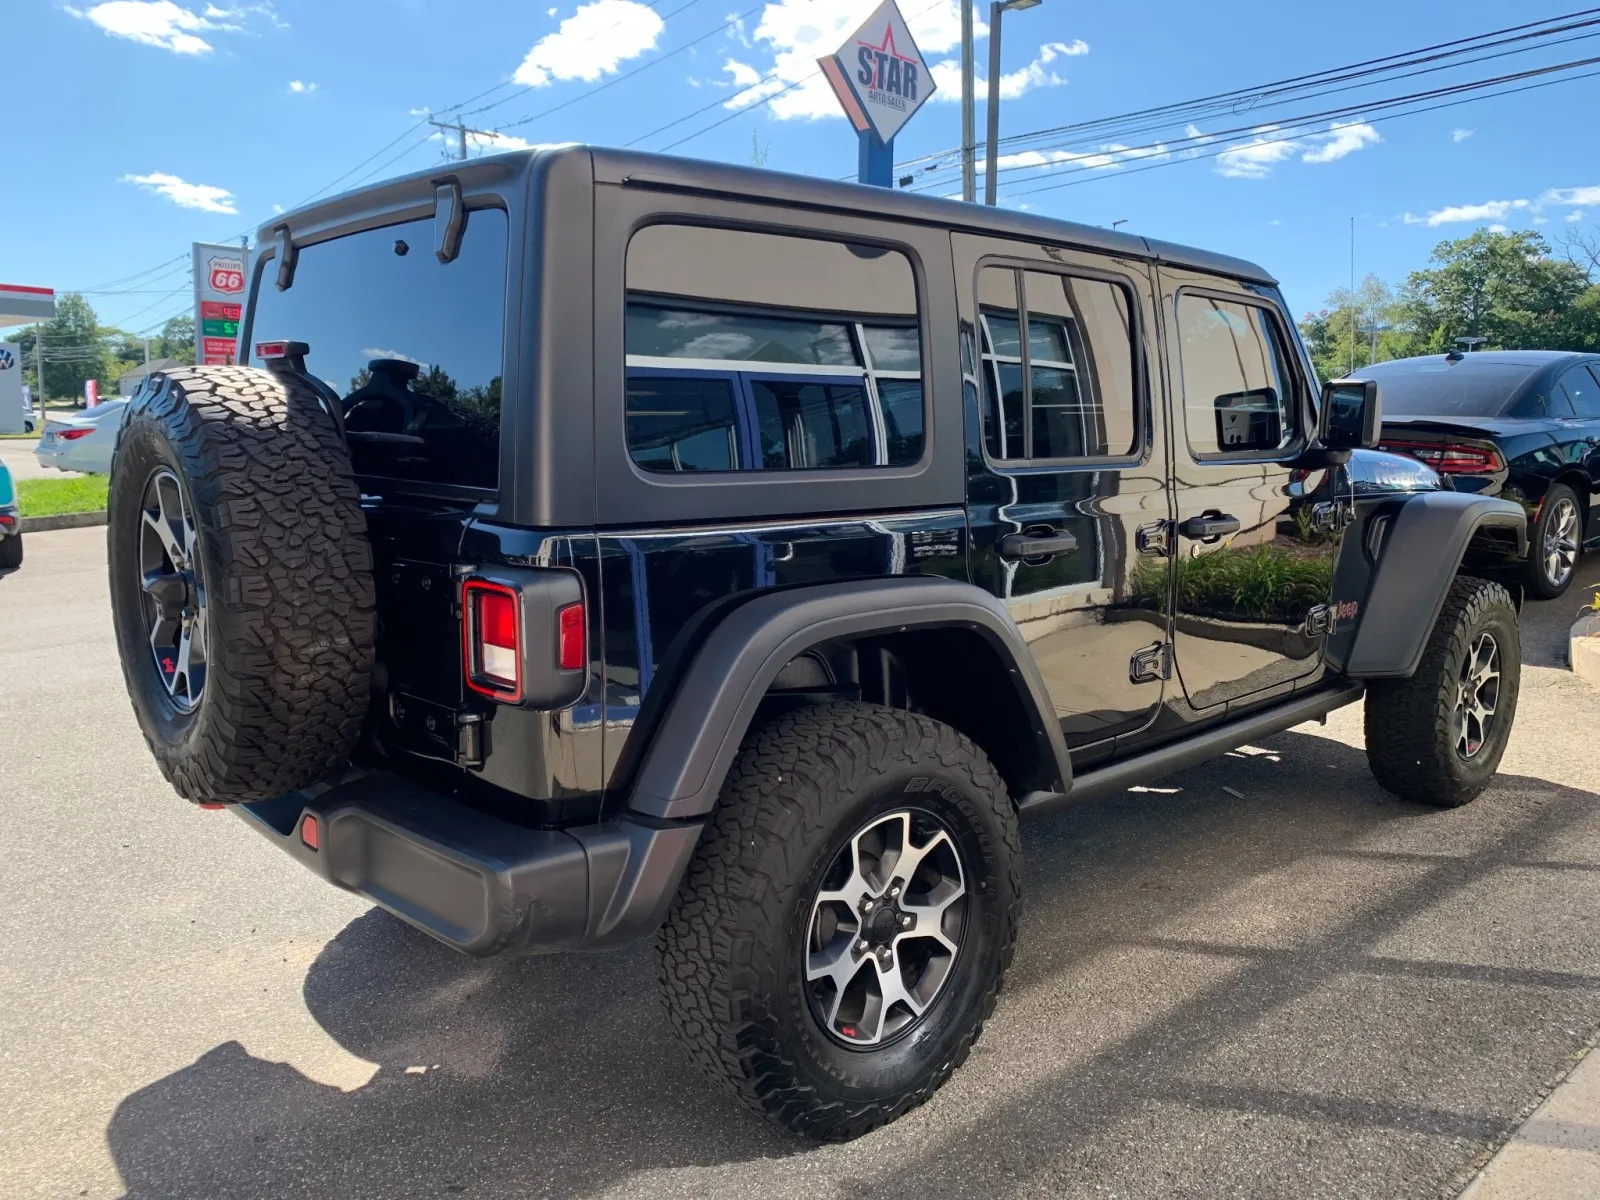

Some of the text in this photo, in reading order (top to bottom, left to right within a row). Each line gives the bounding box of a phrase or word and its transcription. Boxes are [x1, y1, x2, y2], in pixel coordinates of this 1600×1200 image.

[857, 46, 918, 100] STAR
[868, 90, 907, 110] AUTO SALES
[213, 261, 242, 271] PHILLIPS
[215, 272, 241, 288] 66
[1336, 600, 1359, 620] Jeep
